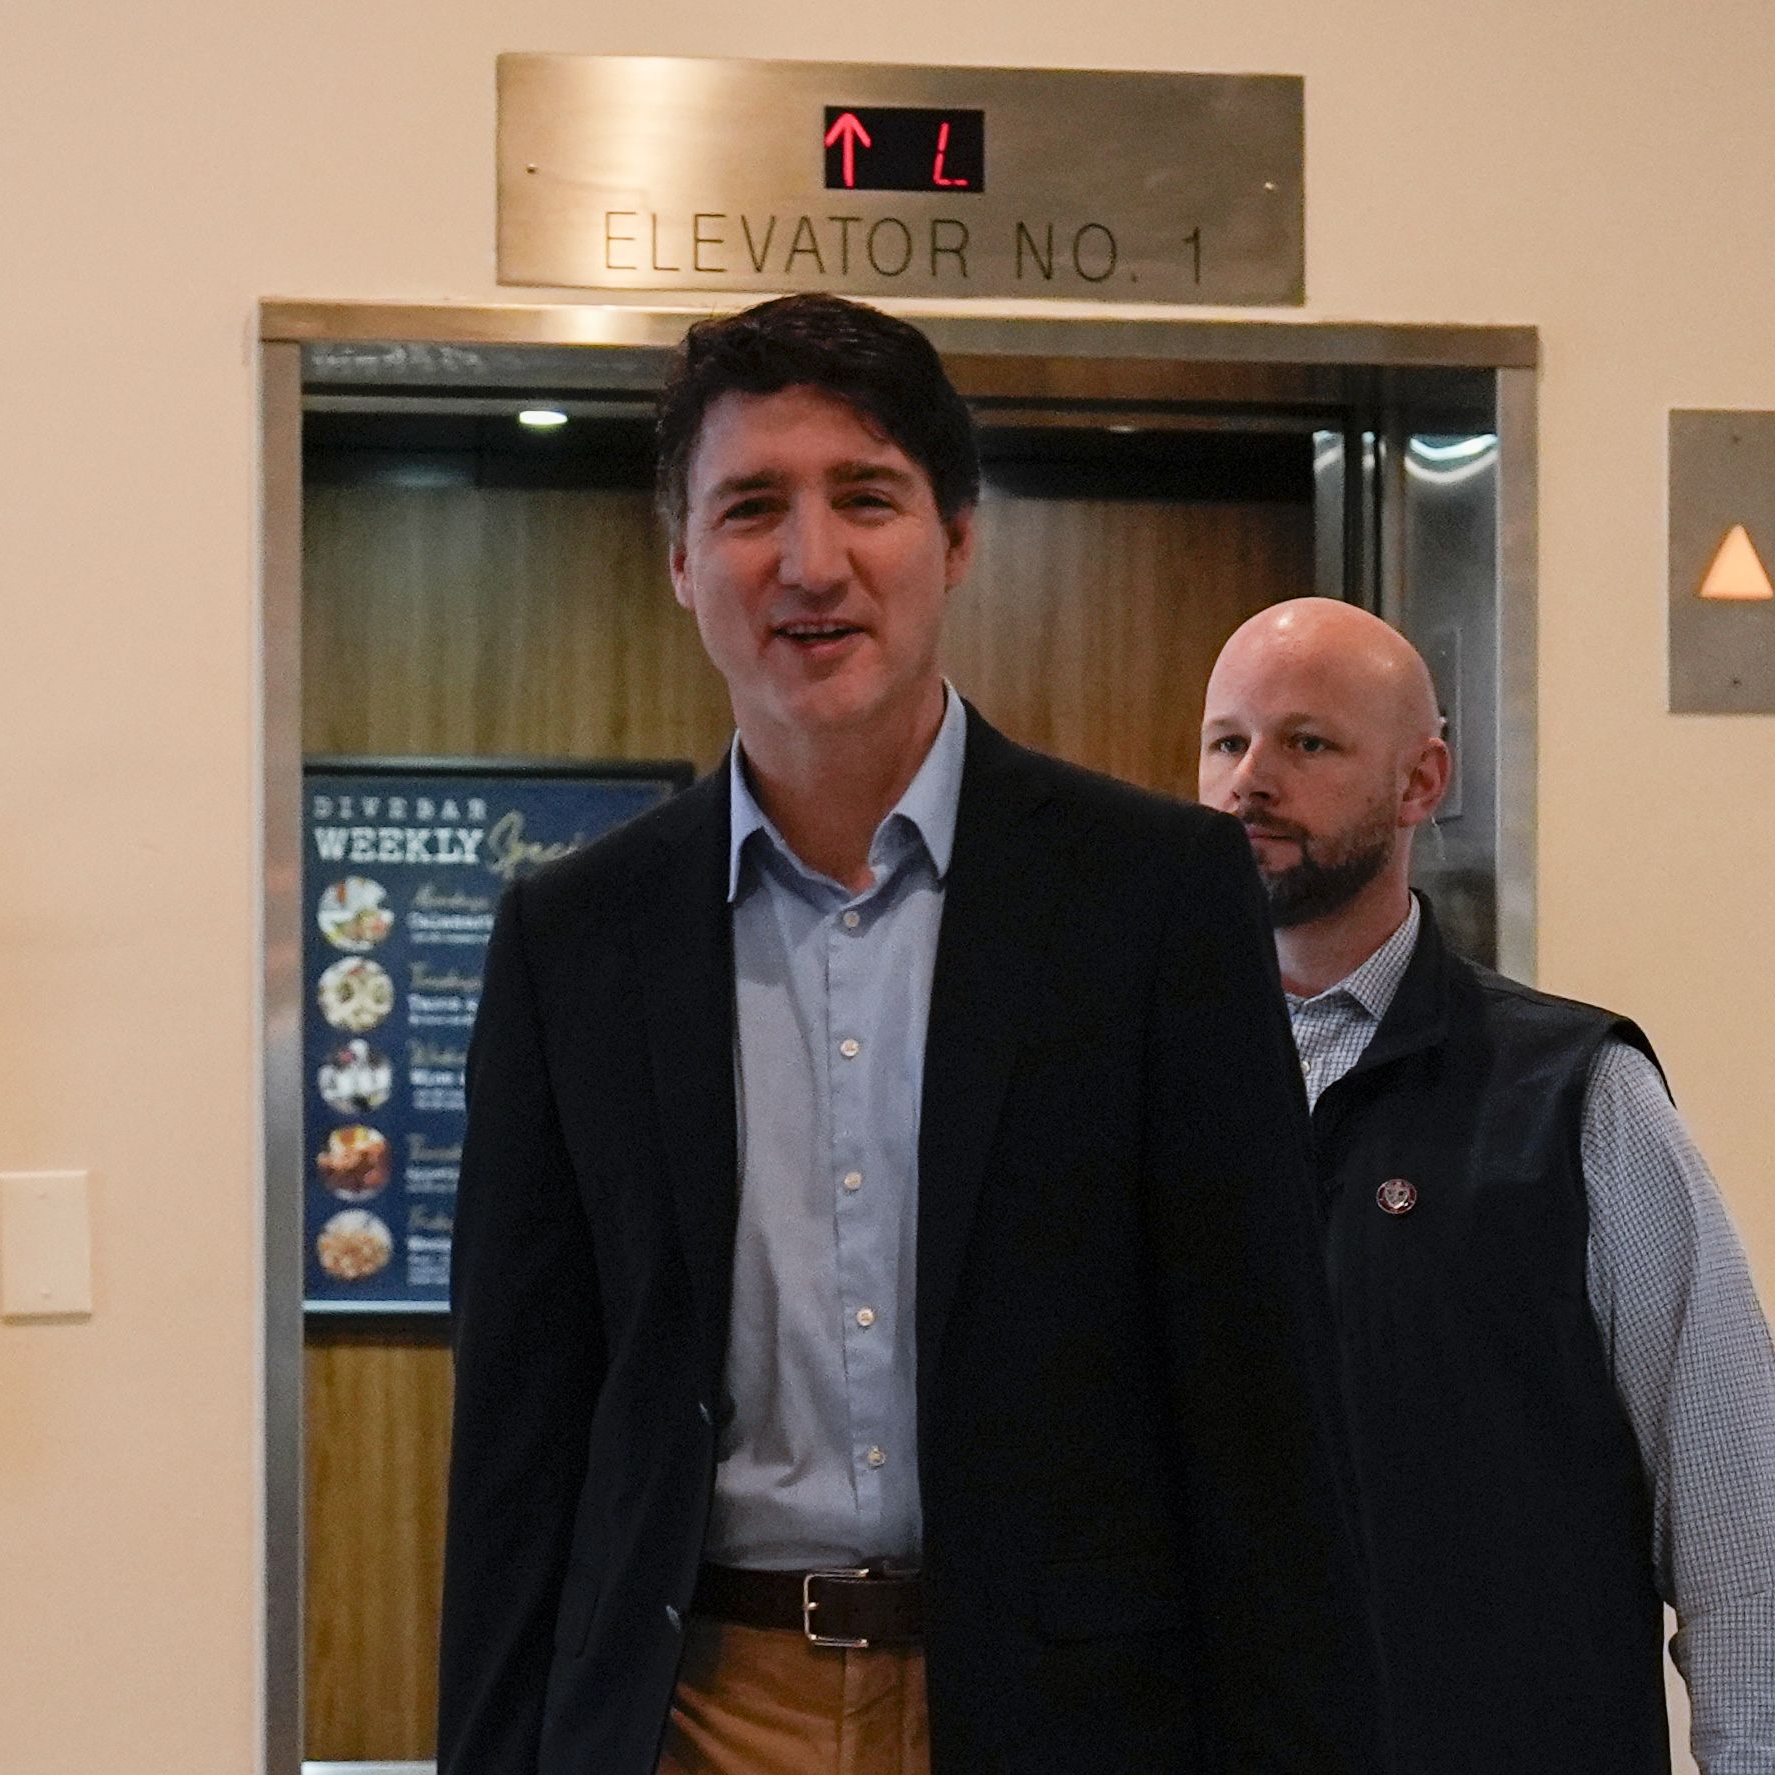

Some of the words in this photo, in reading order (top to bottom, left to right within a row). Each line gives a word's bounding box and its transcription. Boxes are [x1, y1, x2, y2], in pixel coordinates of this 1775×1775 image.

[932, 121, 969, 187] L
[605, 211, 970, 278] ELEVATOR
[1016, 220, 1139, 284] NO.
[1182, 225, 1202, 285] 1
[313, 826, 485, 865] WEEKLY
